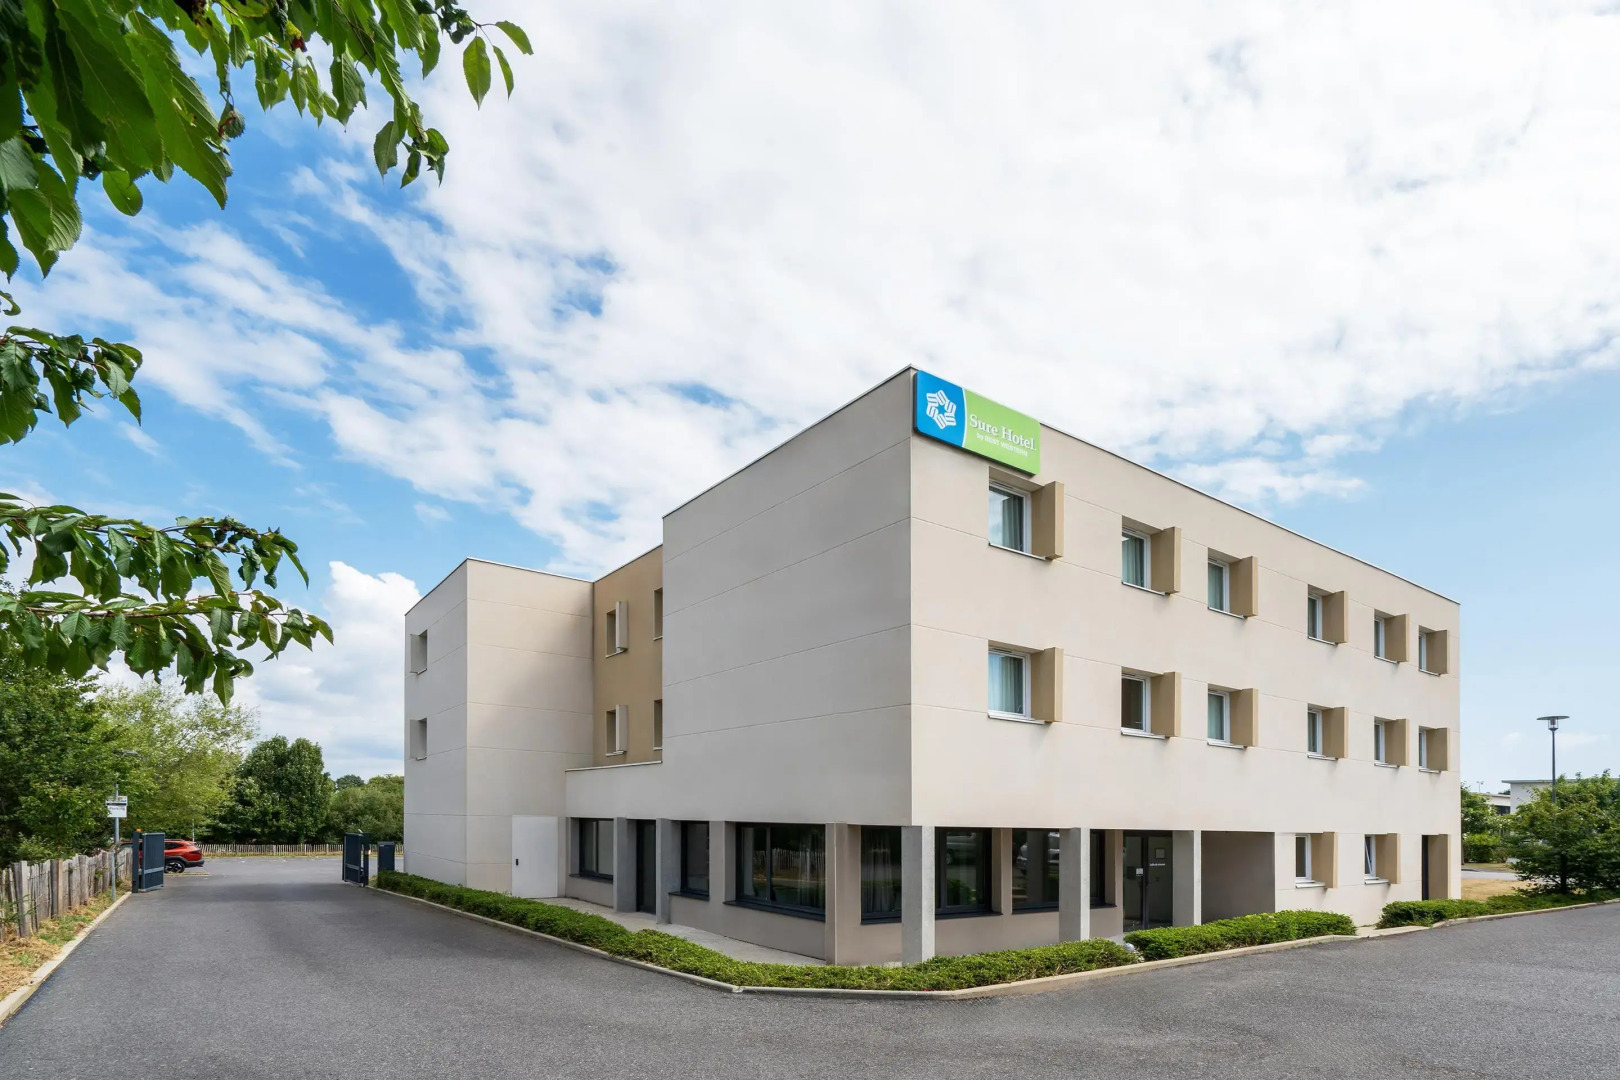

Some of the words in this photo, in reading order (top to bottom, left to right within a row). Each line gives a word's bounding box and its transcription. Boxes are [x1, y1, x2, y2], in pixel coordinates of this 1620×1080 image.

[969, 414, 998, 436] Sure
[1002, 426, 1036, 451] Hotel
[976, 431, 984, 441] by
